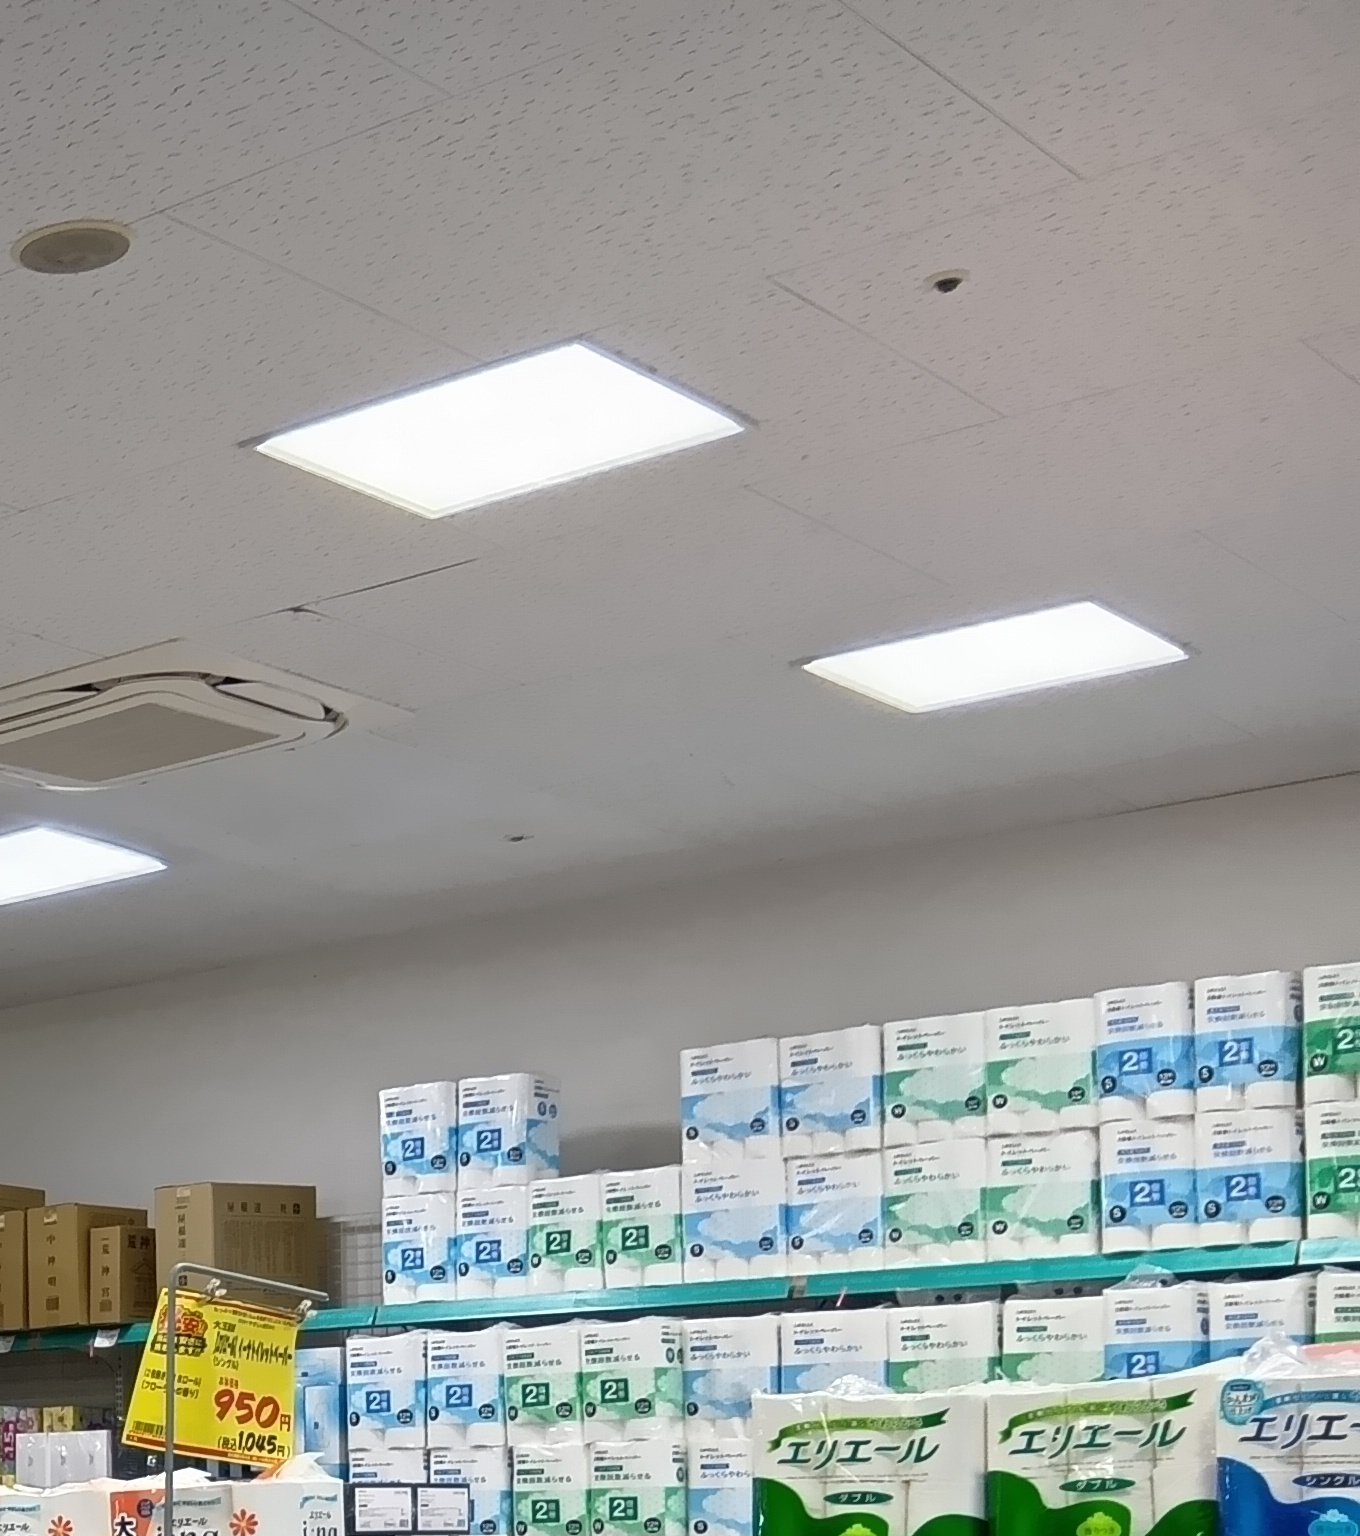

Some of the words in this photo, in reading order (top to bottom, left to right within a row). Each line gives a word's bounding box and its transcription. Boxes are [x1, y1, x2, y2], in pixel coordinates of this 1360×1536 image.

[777, 1434, 940, 1470] エリエール
[1008, 1420, 1188, 1465] エリエール
[839, 1492, 878, 1504] ダブル
